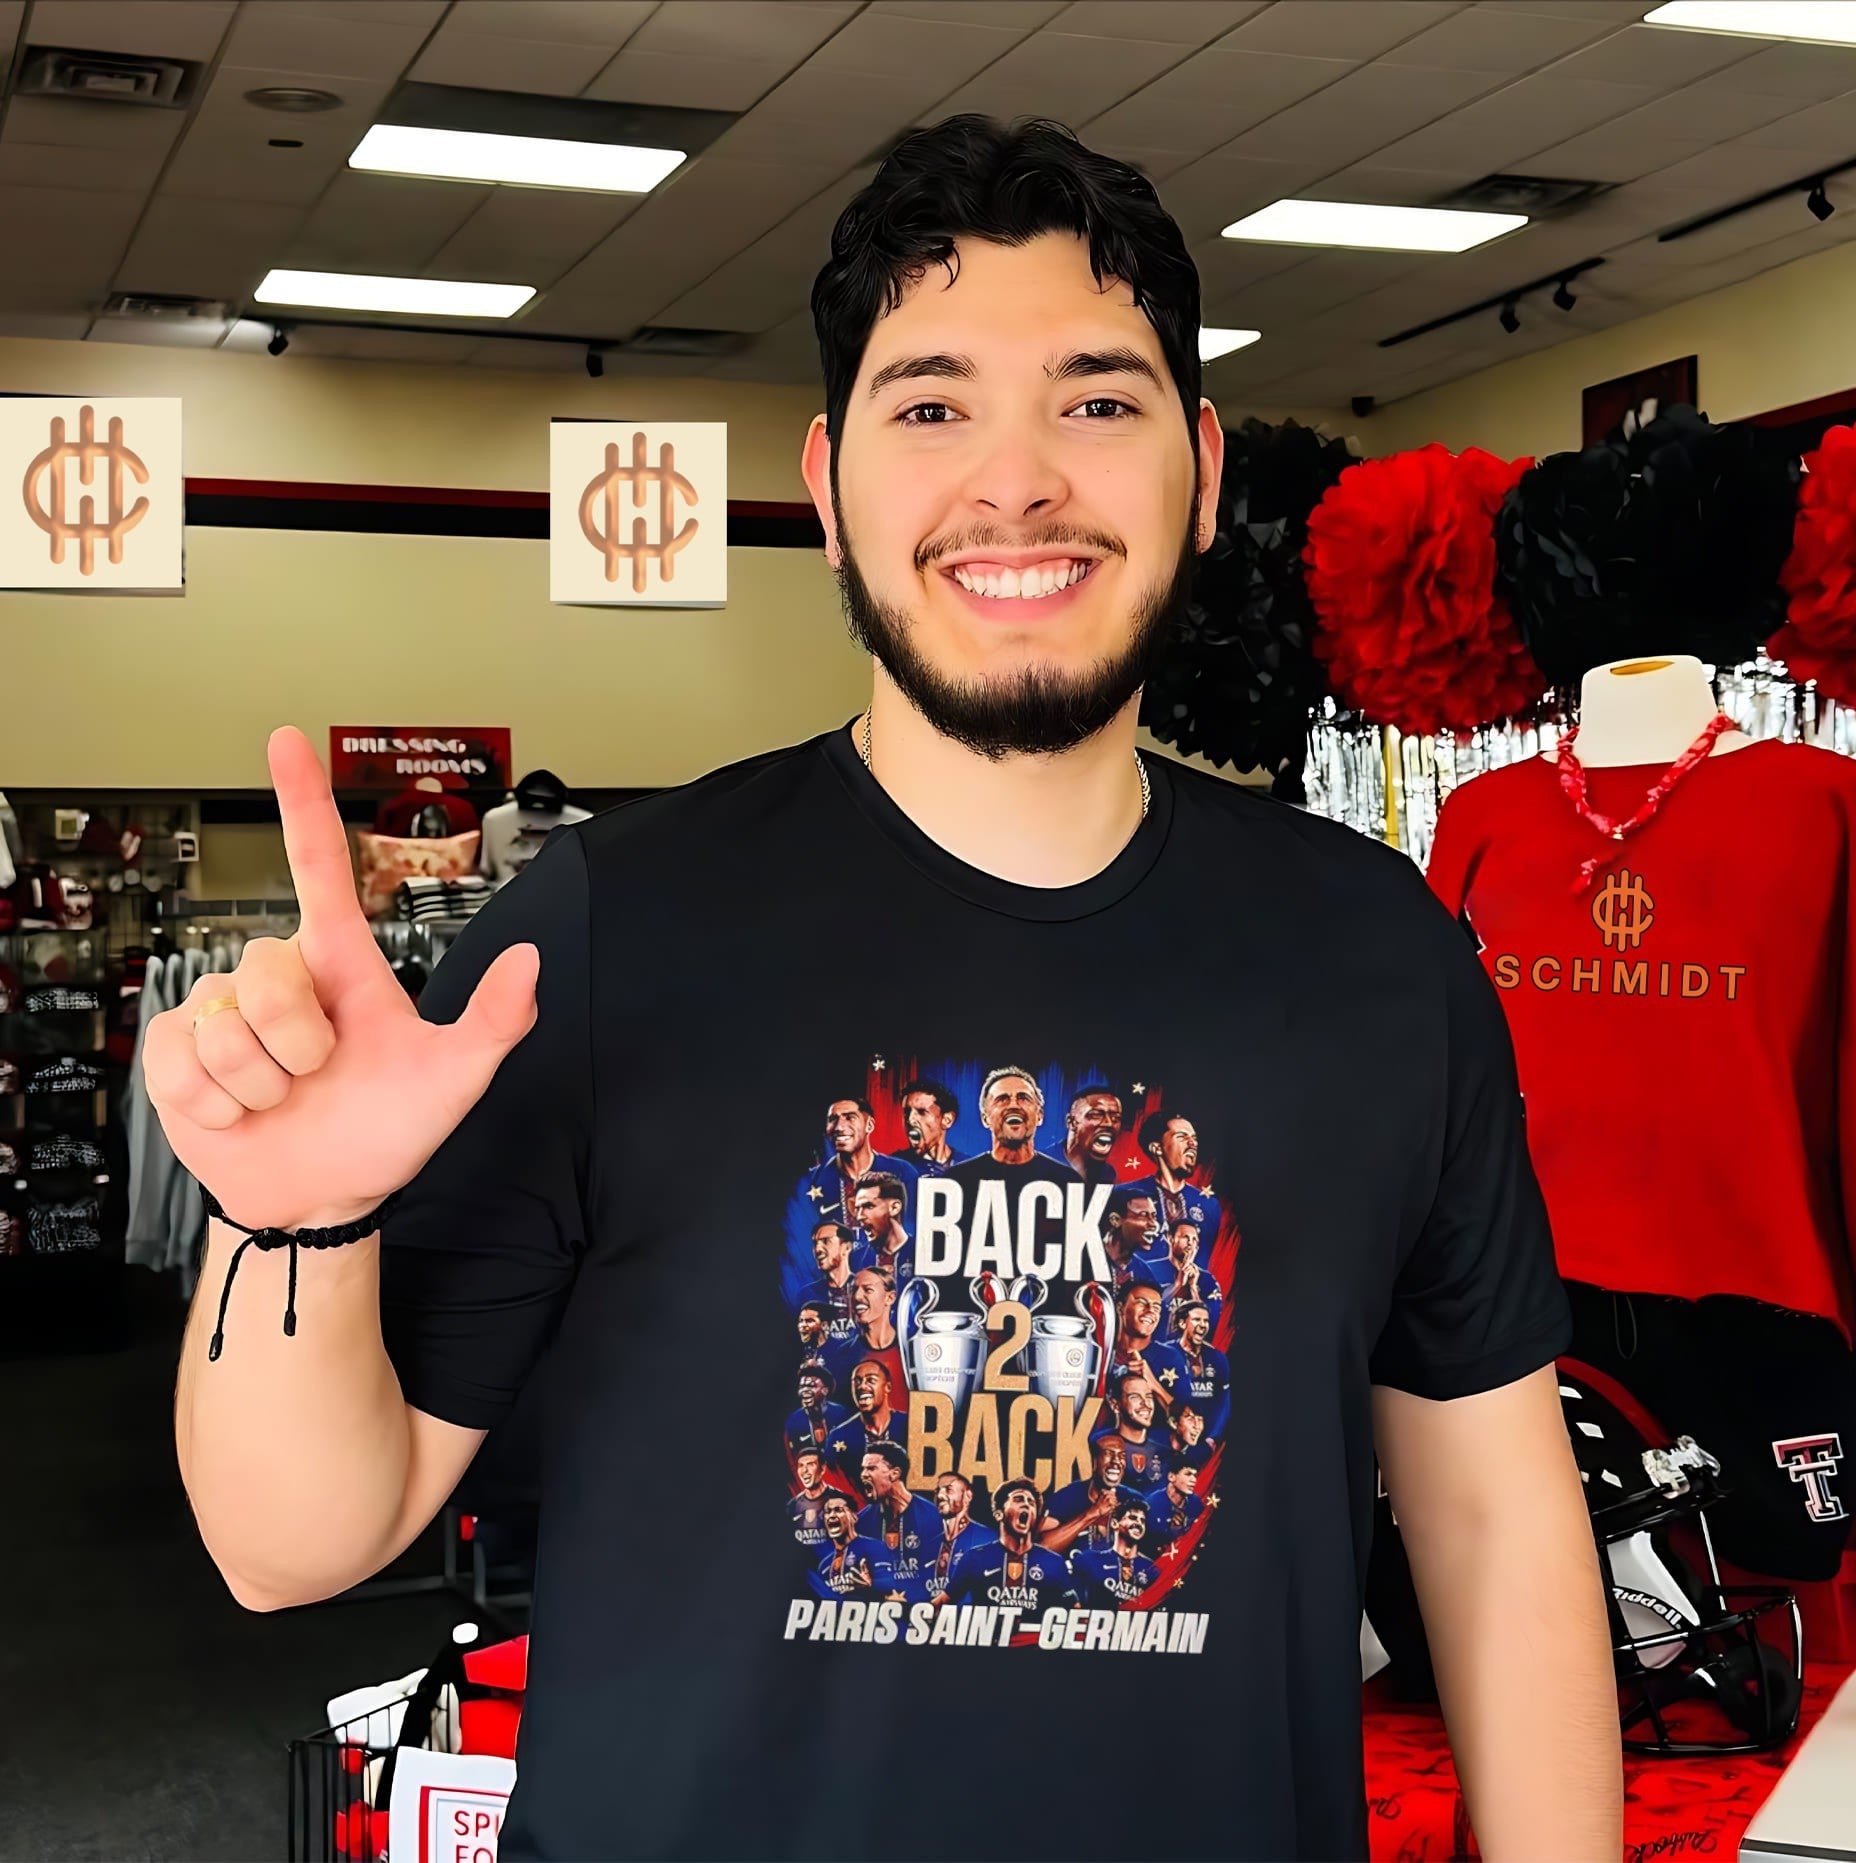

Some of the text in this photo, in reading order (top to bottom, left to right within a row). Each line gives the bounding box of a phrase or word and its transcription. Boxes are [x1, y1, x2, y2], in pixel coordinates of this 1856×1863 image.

[396, 758, 487, 775] ROOMS
[1493, 953, 1747, 1000] SCHMIDT
[914, 1177, 1115, 1283] BACK
[983, 1301, 1032, 1392] 2
[904, 1391, 1105, 1494] BACK
[987, 1585, 1039, 1603] QATAR
[783, 1598, 1210, 1655] PARIS SAINT-GERMAIN
